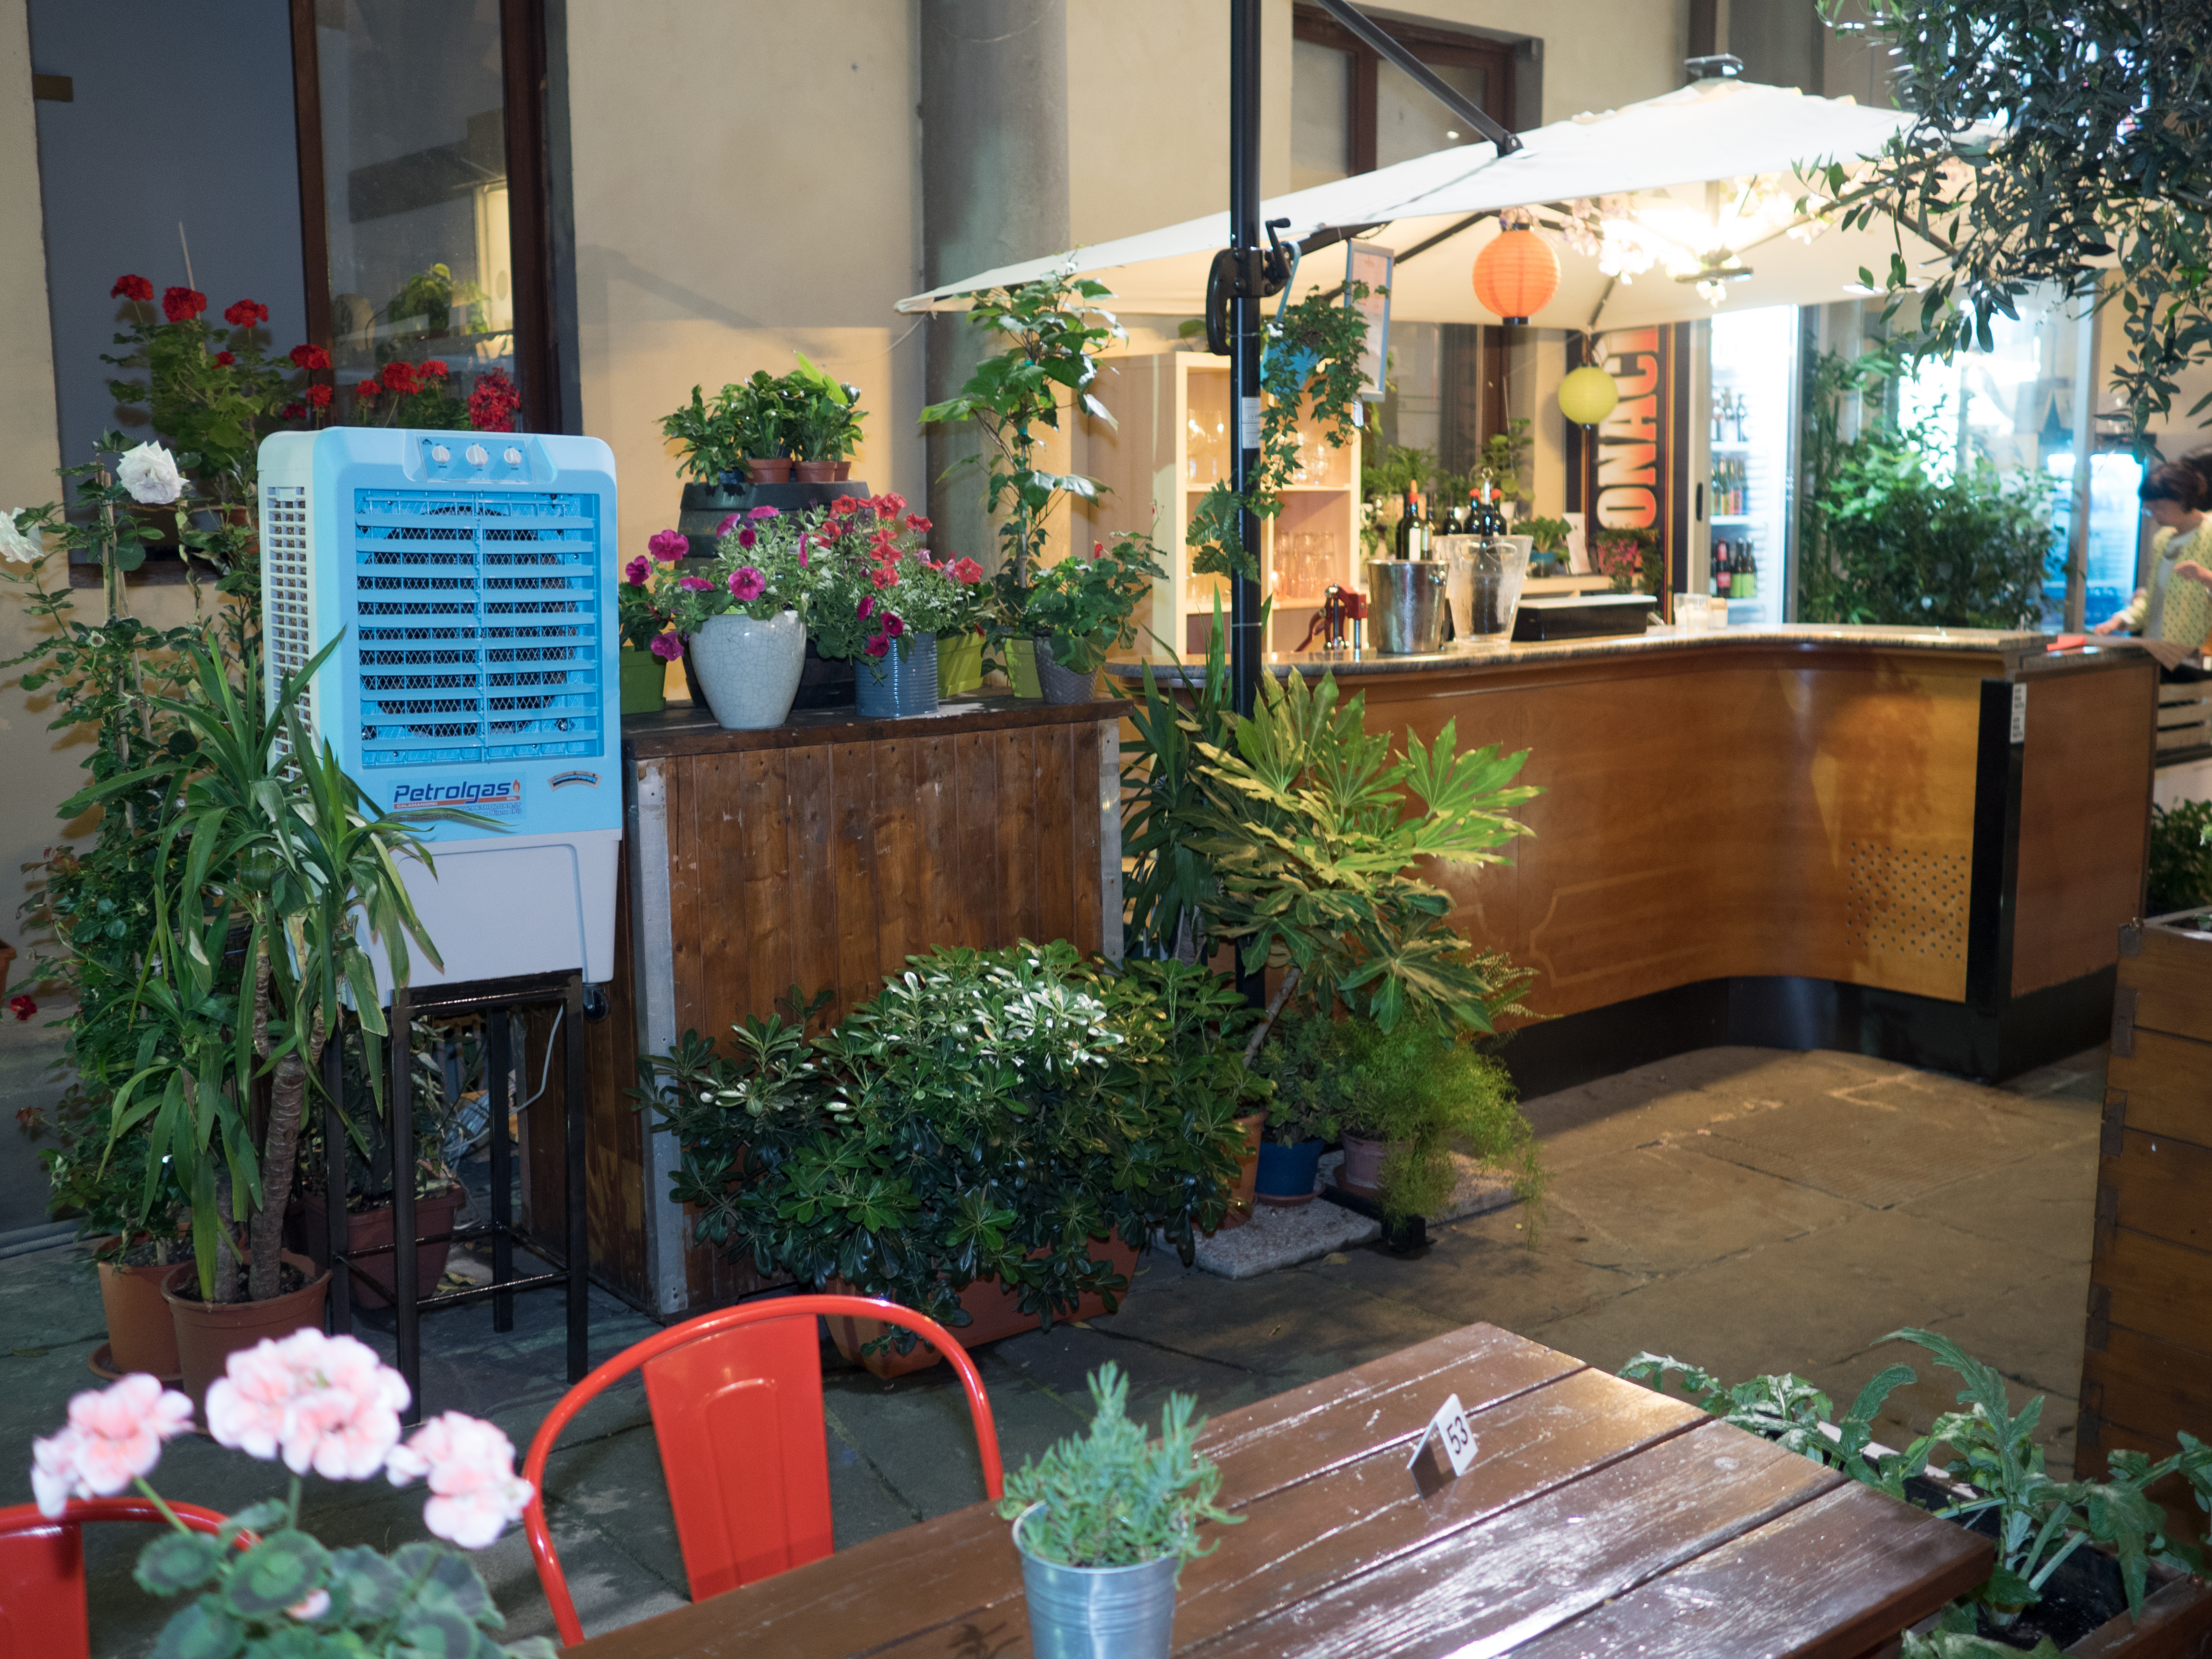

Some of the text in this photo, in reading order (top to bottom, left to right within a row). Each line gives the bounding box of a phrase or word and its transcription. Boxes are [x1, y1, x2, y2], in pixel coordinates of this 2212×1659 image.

[394, 781, 511, 804] Petrolgas
[454, 803, 521, 811] WW.PETROLGAS.IT
[1446, 1416, 1468, 1455] 53
